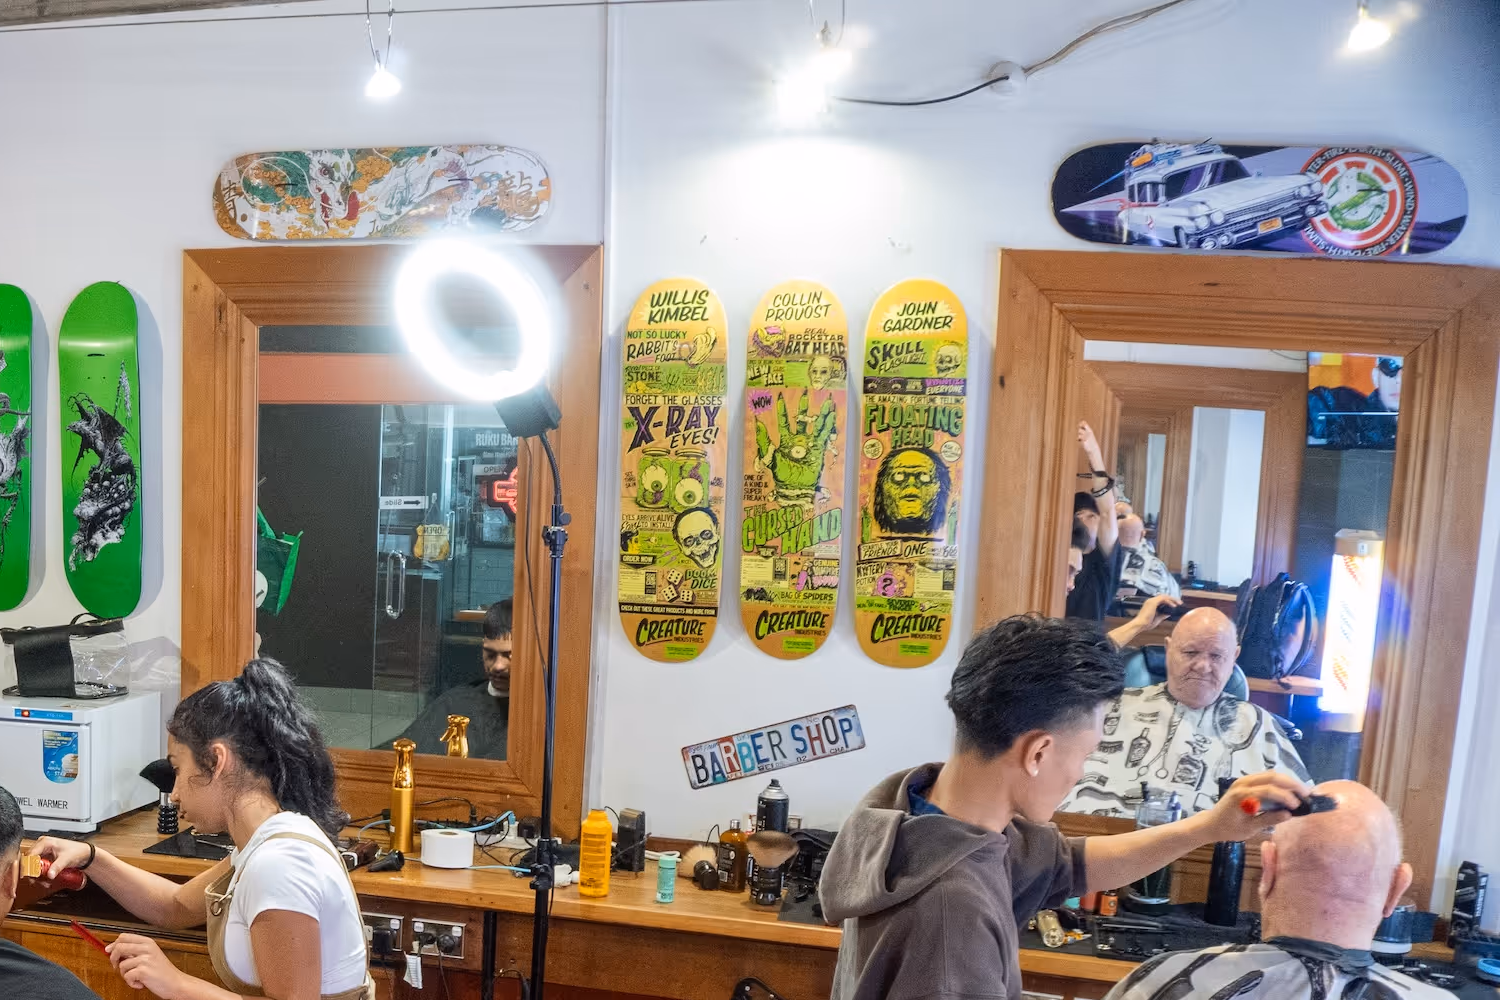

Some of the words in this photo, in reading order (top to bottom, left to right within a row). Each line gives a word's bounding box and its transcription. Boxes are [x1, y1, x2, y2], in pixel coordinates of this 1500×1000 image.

[1404, 182, 1416, 210] WIND
[650, 289, 710, 309] WILLIS
[772, 290, 823, 308] COLLIN
[647, 306, 710, 325] KIMBEL
[897, 300, 939, 317] JOHN
[804, 327, 829, 335] REAL
[883, 315, 954, 333] GARDNER
[627, 330, 644, 339] NOT
[645, 330, 658, 339] SO
[660, 330, 688, 339] LUCKY
[788, 334, 845, 342] ROCKSTAR
[784, 341, 811, 356] BAT
[812, 341, 847, 357] HEAD
[867, 340, 925, 370] SKULL
[626, 371, 663, 382] STONE
[747, 363, 771, 379] NEW
[625, 394, 659, 405] FORGET
[662, 394, 679, 405] THE
[681, 395, 723, 406] GLASSES
[752, 395, 772, 409] WOW
[864, 403, 964, 437] FLOATING
[627, 405, 721, 454] X-RAY
[669, 426, 720, 449] EYES!
[891, 427, 935, 449] HEAD
[475, 433, 500, 446] RUKU
[742, 506, 804, 553] CURSED
[781, 506, 842, 557] HAND
[862, 547, 898, 559] FRIENDS
[903, 541, 929, 558] ONE
[690, 578, 718, 590] DICE
[780, 591, 793, 599] BAG
[802, 592, 834, 601] SPIDERS
[635, 617, 707, 647] CREATURE
[755, 609, 830, 640] CREATURE
[871, 613, 946, 644] CREATURE
[690, 729, 789, 784] BARBER
[790, 714, 854, 757] SHOP
[37, 797, 69, 810] WARMER
